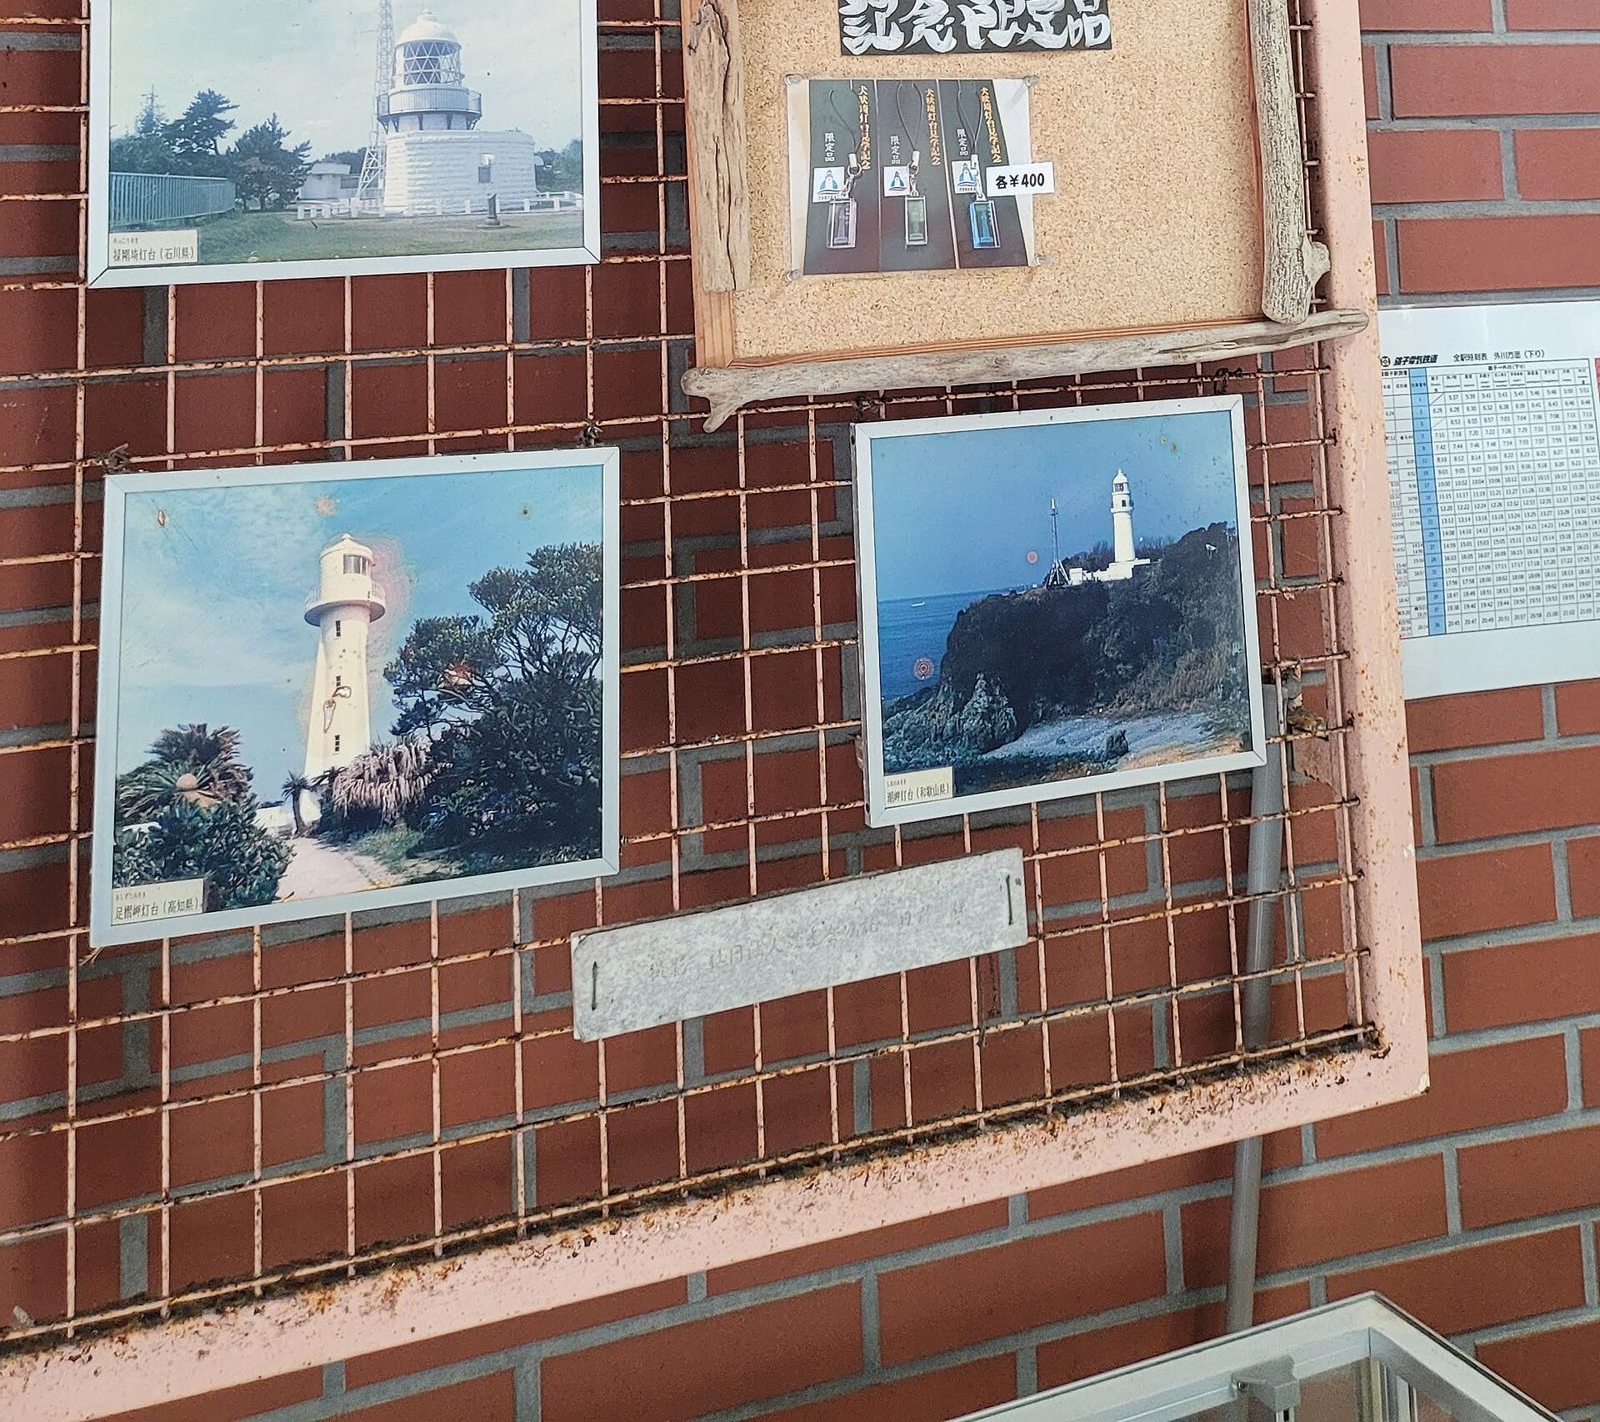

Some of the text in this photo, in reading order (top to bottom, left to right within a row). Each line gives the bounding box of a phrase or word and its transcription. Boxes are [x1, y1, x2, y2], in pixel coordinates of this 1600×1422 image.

[824, 132, 836, 162] 限定品
[890, 135, 901, 164] 限定品
[957, 128, 969, 156] 限定品
